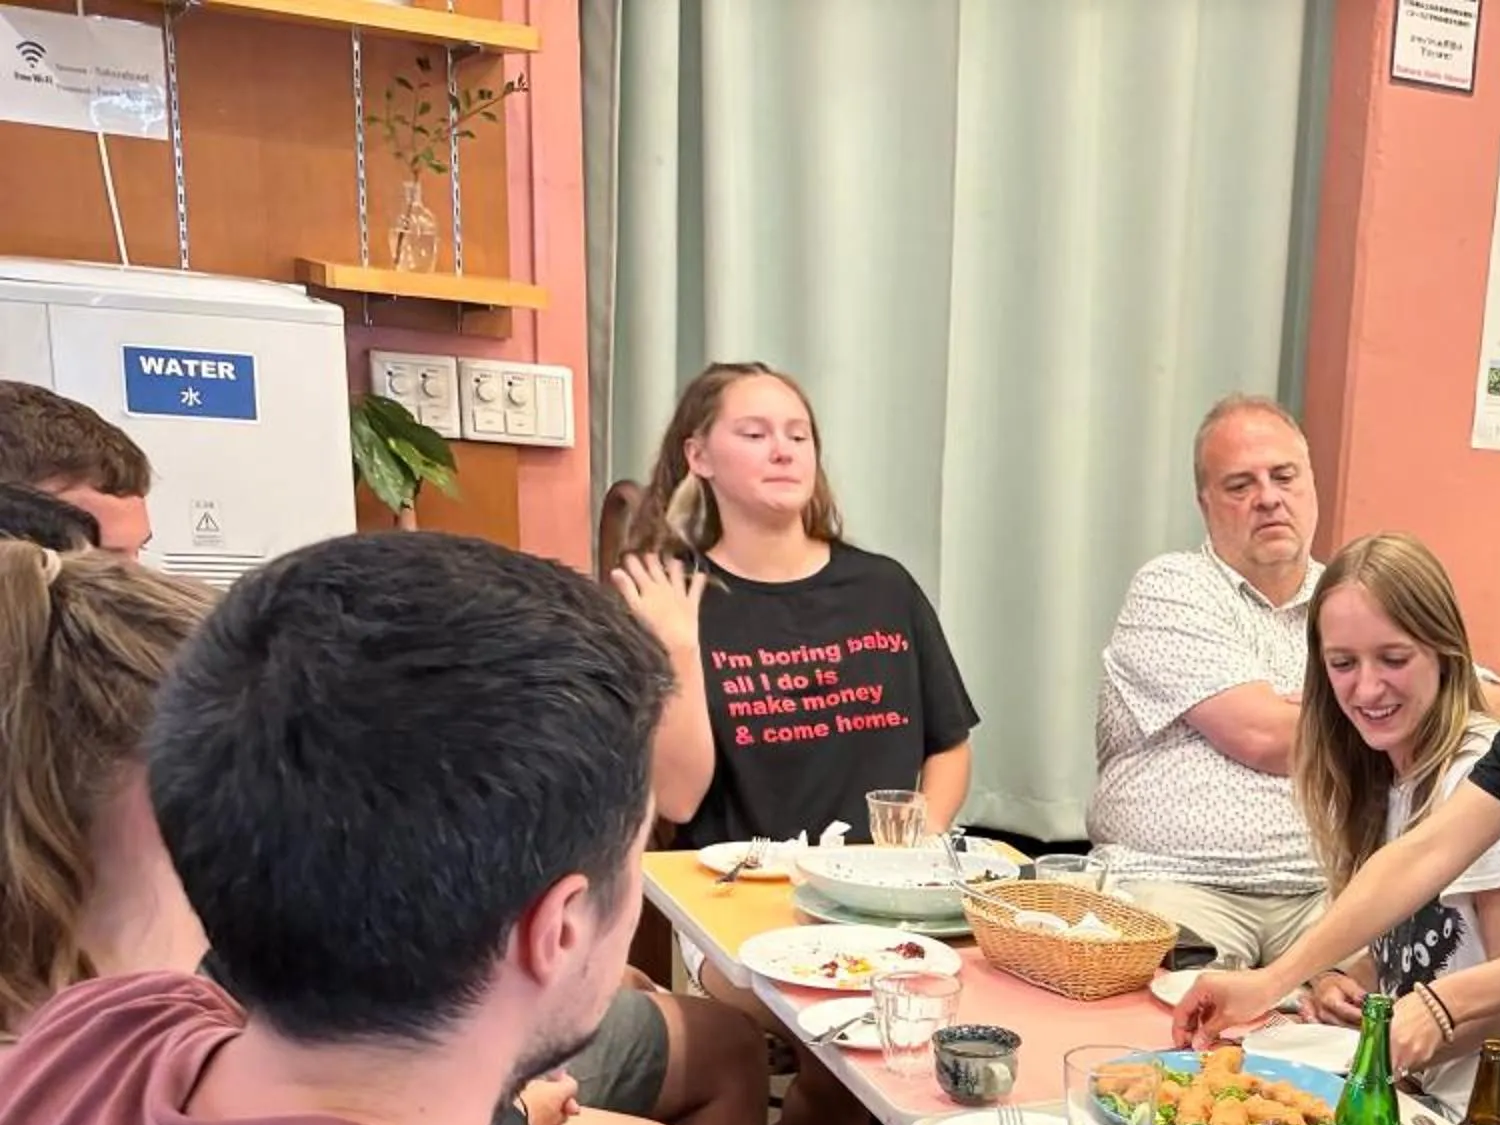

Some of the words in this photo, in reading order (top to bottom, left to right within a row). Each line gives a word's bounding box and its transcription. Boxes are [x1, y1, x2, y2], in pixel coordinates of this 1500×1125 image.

[139, 355, 236, 381] WATER
[180, 386, 203, 408] 水
[711, 651, 753, 670] I'm
[758, 644, 842, 666] boring
[722, 674, 755, 695] all
[760, 673, 771, 691] I
[777, 673, 809, 691] do
[814, 668, 839, 686] is
[728, 695, 798, 718] make
[802, 684, 884, 711] money
[735, 725, 755, 746] &
[762, 722, 830, 744] come
[835, 710, 909, 734] home.
